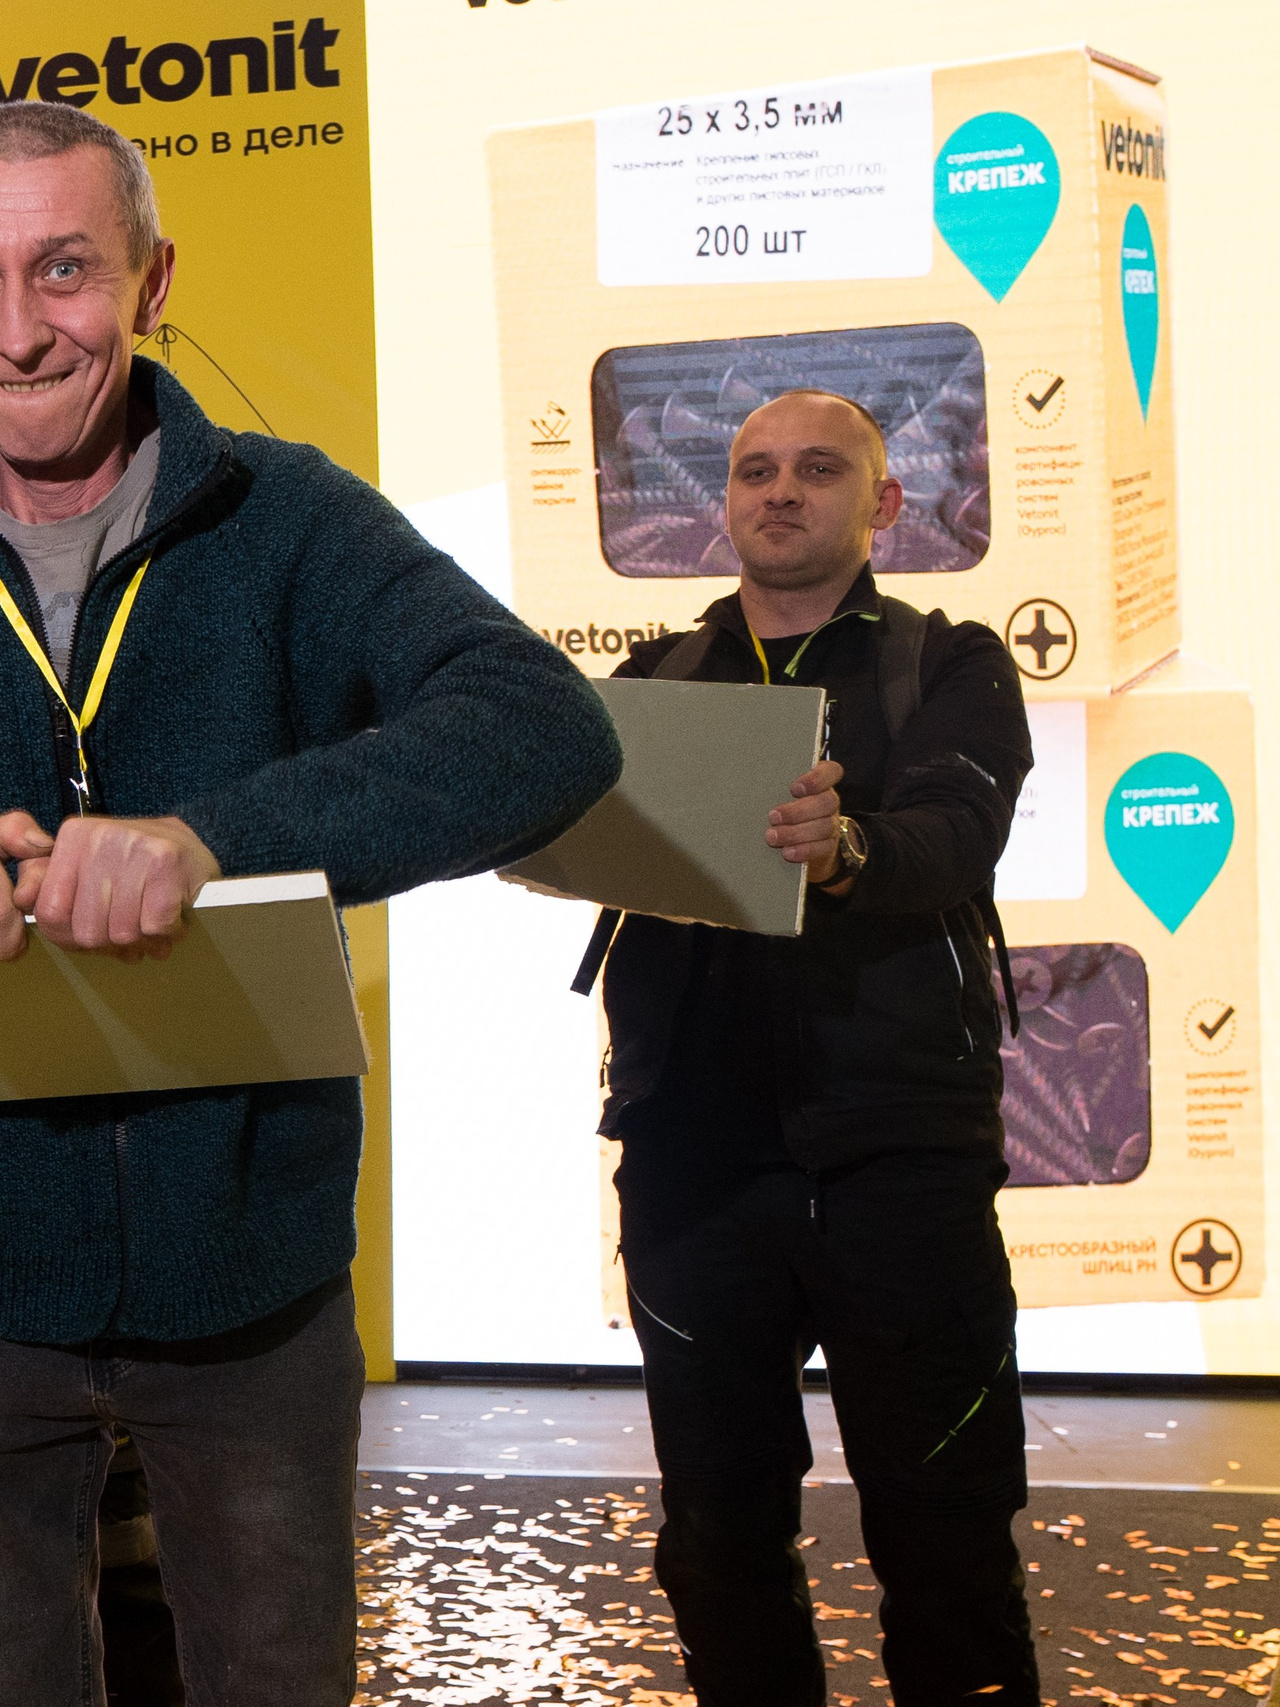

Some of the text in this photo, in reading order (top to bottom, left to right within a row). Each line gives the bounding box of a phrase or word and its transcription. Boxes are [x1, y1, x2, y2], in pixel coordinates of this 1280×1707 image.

[658, 106, 693, 136] 25
[734, 97, 780, 137] 3,5
[211, 131, 232, 153] в
[243, 122, 344, 156] деле
[1101, 116, 1165, 182] vetonit
[947, 161, 1046, 195] КРЕПЕЖ
[696, 224, 749, 257] 200
[1123, 802, 1220, 828] КРЕПЕЖ
[1009, 1236, 1157, 1258] КРЕСТООБРАЗНЫЙ
[1083, 1259, 1132, 1275] ШЛИЦ
